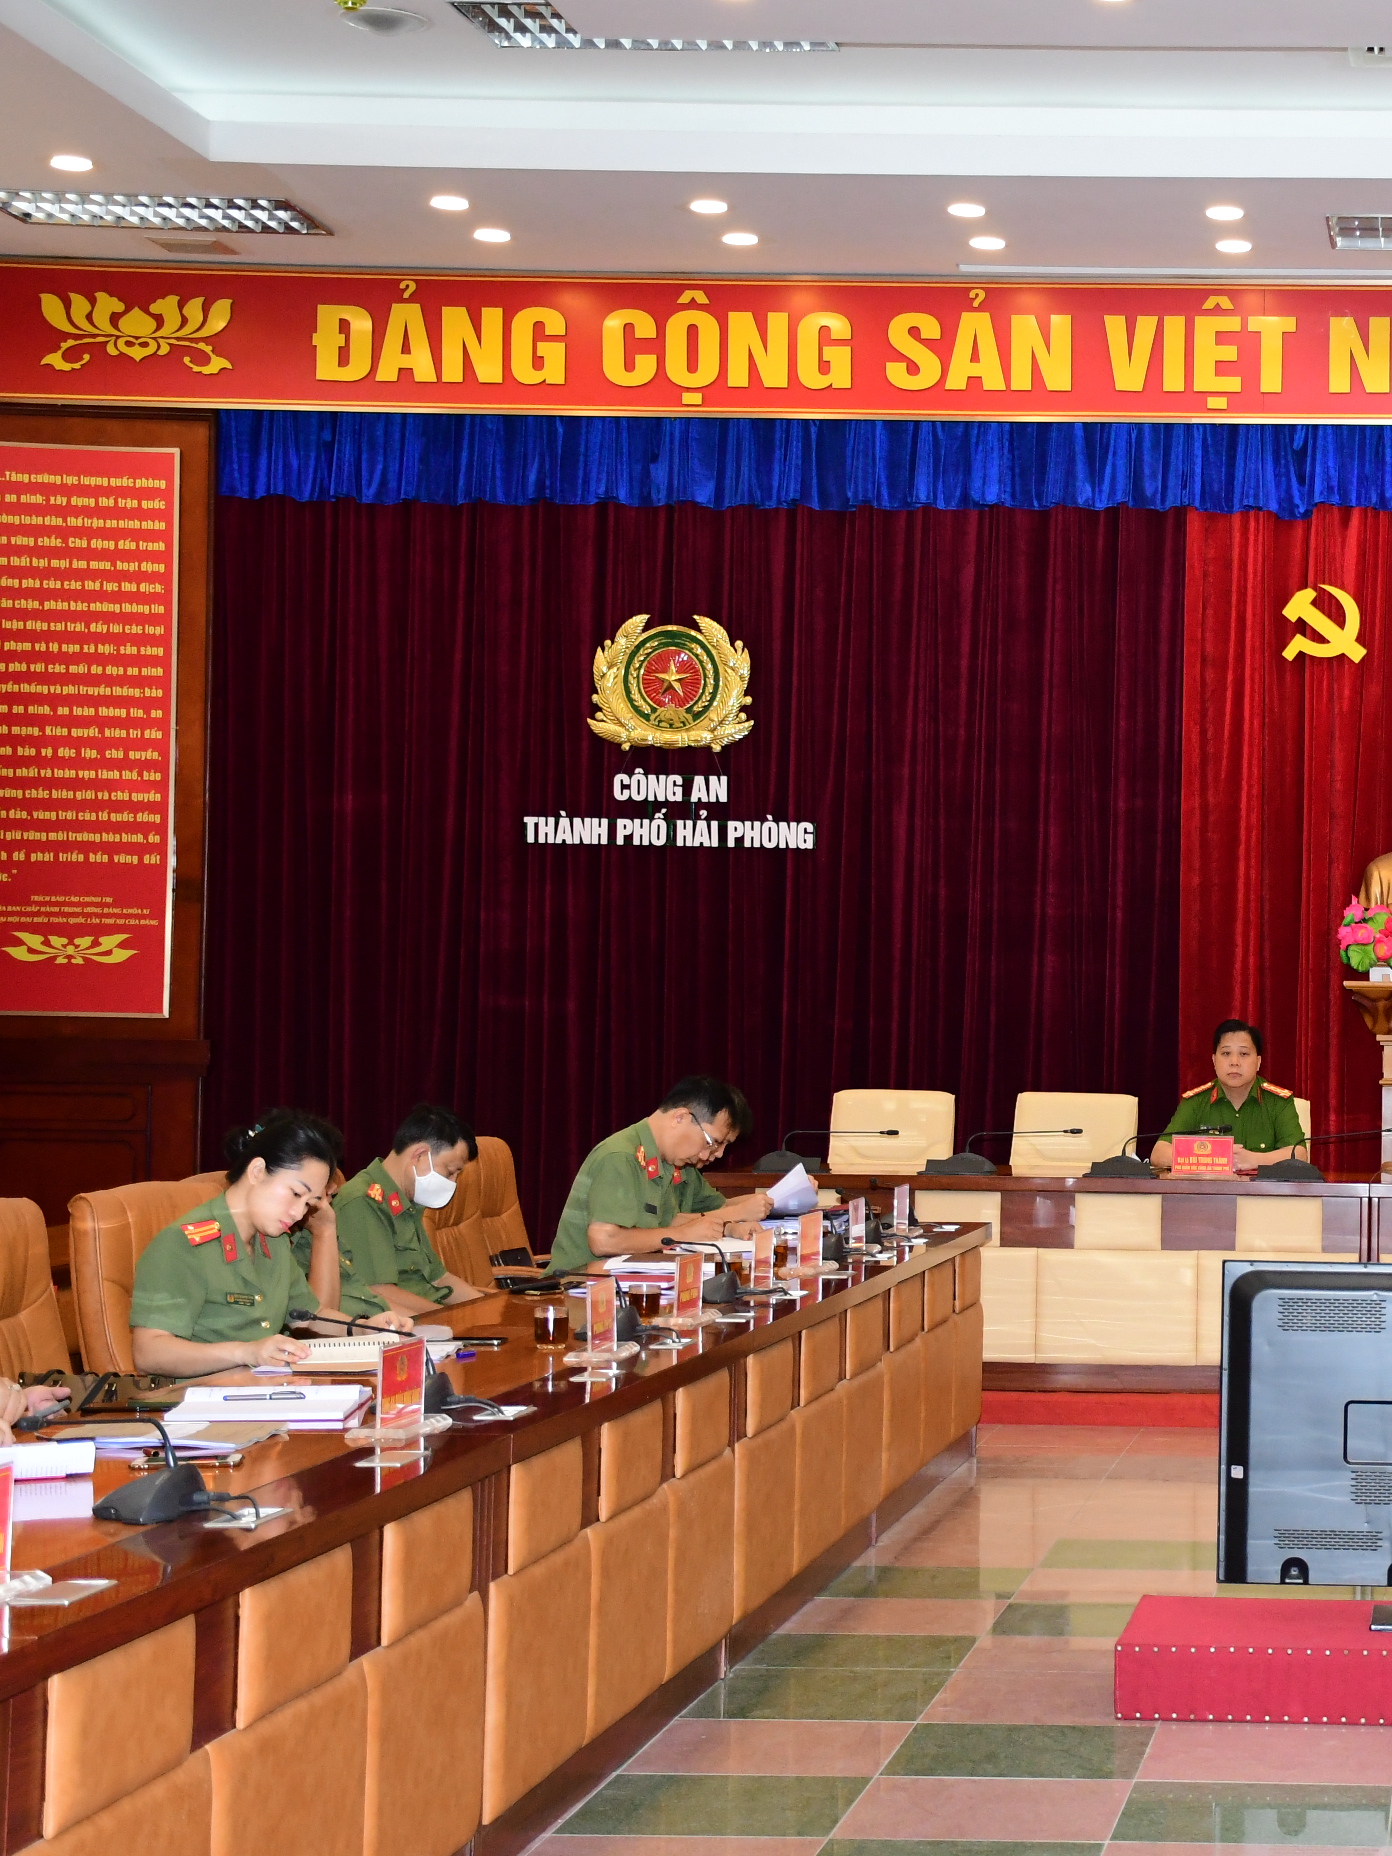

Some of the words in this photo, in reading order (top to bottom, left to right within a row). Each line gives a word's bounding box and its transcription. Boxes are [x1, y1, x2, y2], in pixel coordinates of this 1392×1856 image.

[312, 280, 566, 386] ĐẢNG
[602, 290, 852, 404] CỘNG
[885, 288, 1073, 391] SẢN
[1104, 295, 1297, 408] VIỆT
[614, 768, 682, 802] CÔNG
[690, 776, 728, 802] AN
[524, 810, 608, 844] THÀNH
[616, 808, 667, 846] PHỐ
[676, 810, 718, 847] HẢI
[728, 815, 814, 849] PHÒNG
